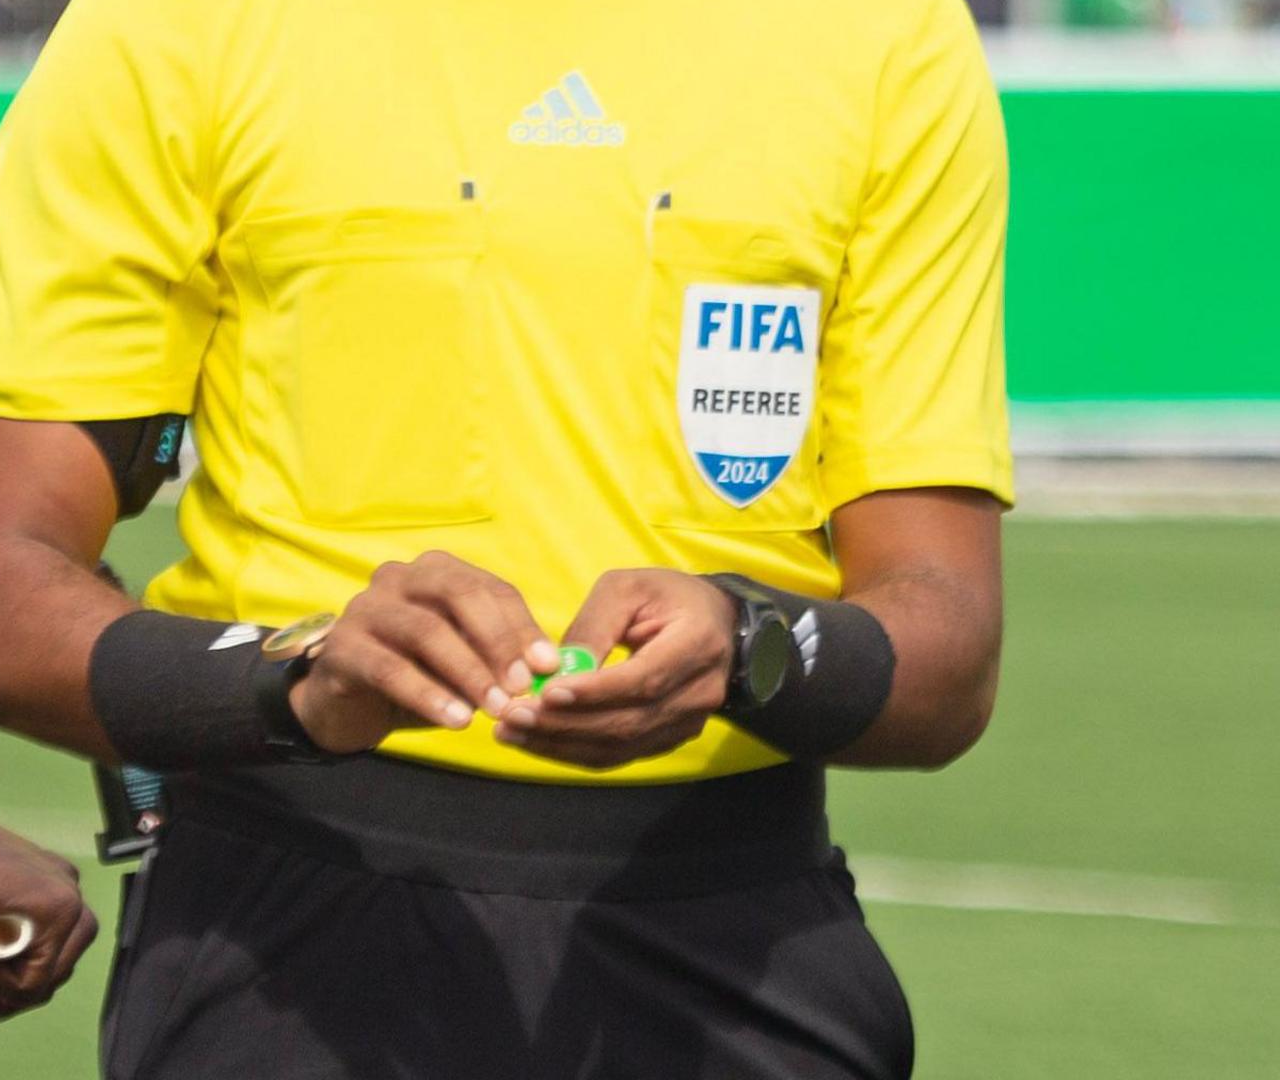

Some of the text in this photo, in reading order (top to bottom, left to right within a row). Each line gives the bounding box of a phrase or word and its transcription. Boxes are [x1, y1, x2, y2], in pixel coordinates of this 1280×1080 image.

[508, 120, 626, 146] adidas
[697, 301, 805, 353] FIFA
[692, 388, 801, 416] REFEREE
[717, 460, 770, 485] 2024
